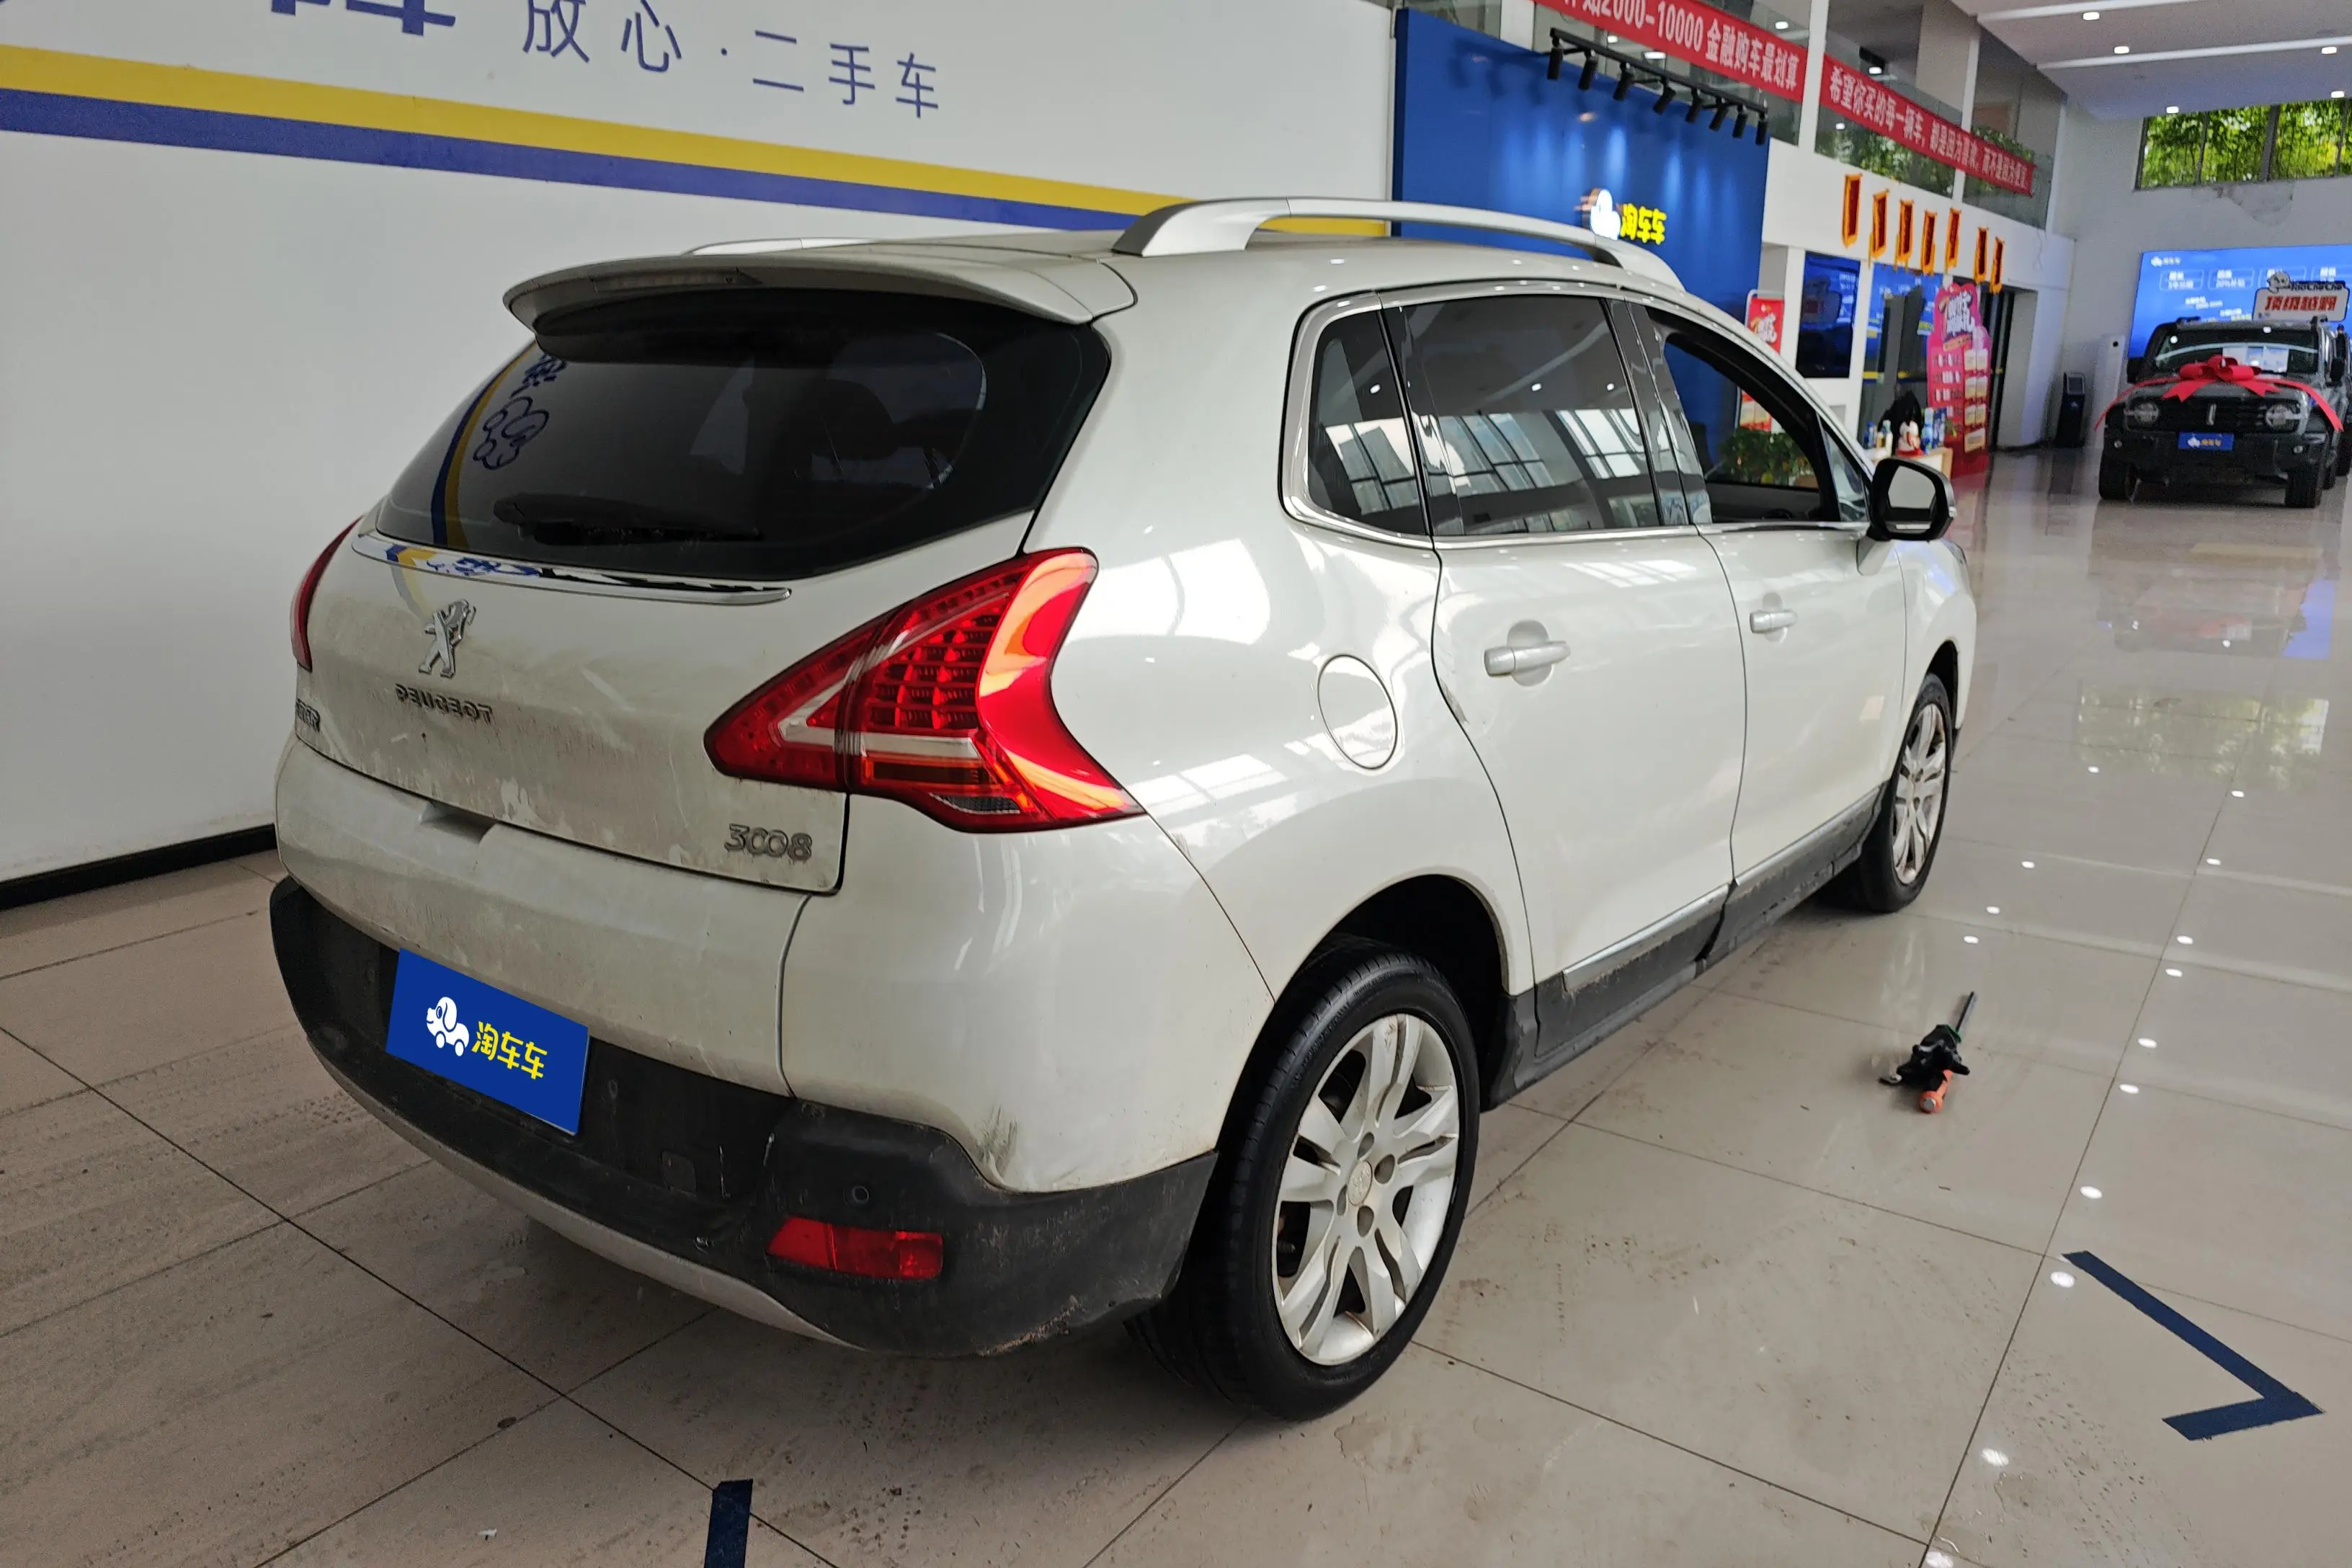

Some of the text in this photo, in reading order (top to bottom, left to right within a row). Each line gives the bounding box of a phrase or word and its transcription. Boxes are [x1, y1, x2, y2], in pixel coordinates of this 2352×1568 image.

[1619, 202, 1667, 245] 淘车车
[396, 683, 493, 724] PEUGEOT
[724, 823, 813, 861] 3008
[471, 1021, 548, 1079] 淘车车
